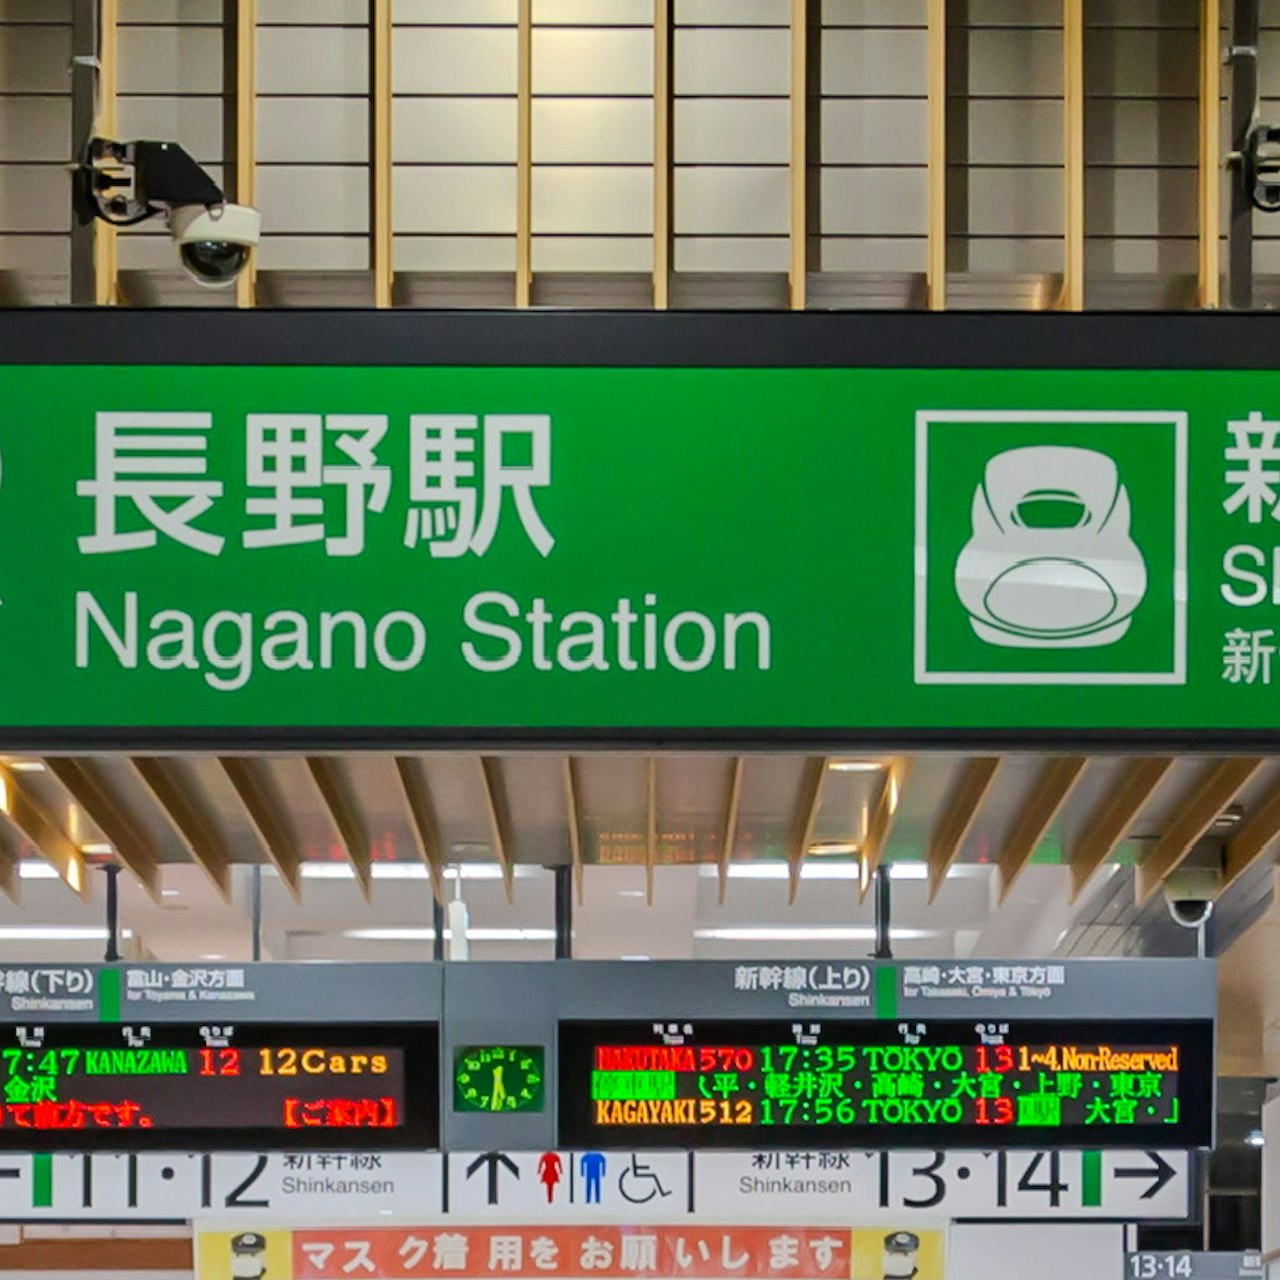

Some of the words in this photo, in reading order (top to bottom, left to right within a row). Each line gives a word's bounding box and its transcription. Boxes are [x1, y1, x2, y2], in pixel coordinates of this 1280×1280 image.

[77, 411, 555, 557] 長野駅
[76, 592, 426, 691] Nagano
[463, 592, 771, 671] Station
[86, 1050, 188, 1075] KANAZAWA
[200, 1049, 241, 1076] 12
[700, 1047, 754, 1072] 570
[760, 1046, 856, 1072] 17:35
[976, 1046, 1015, 1072] 13
[596, 1099, 696, 1124] KAGAYAKI
[699, 1099, 753, 1125] 512
[760, 1099, 856, 1125] 17:56
[976, 1098, 1015, 1125] 13
[281, 1177, 396, 1195] Shinkansen
[738, 1175, 852, 1195] Shinkansen
[302, 1233, 845, 1272] マスク着用をお願いします
[1130, 1254, 1193, 1279] 13・14
